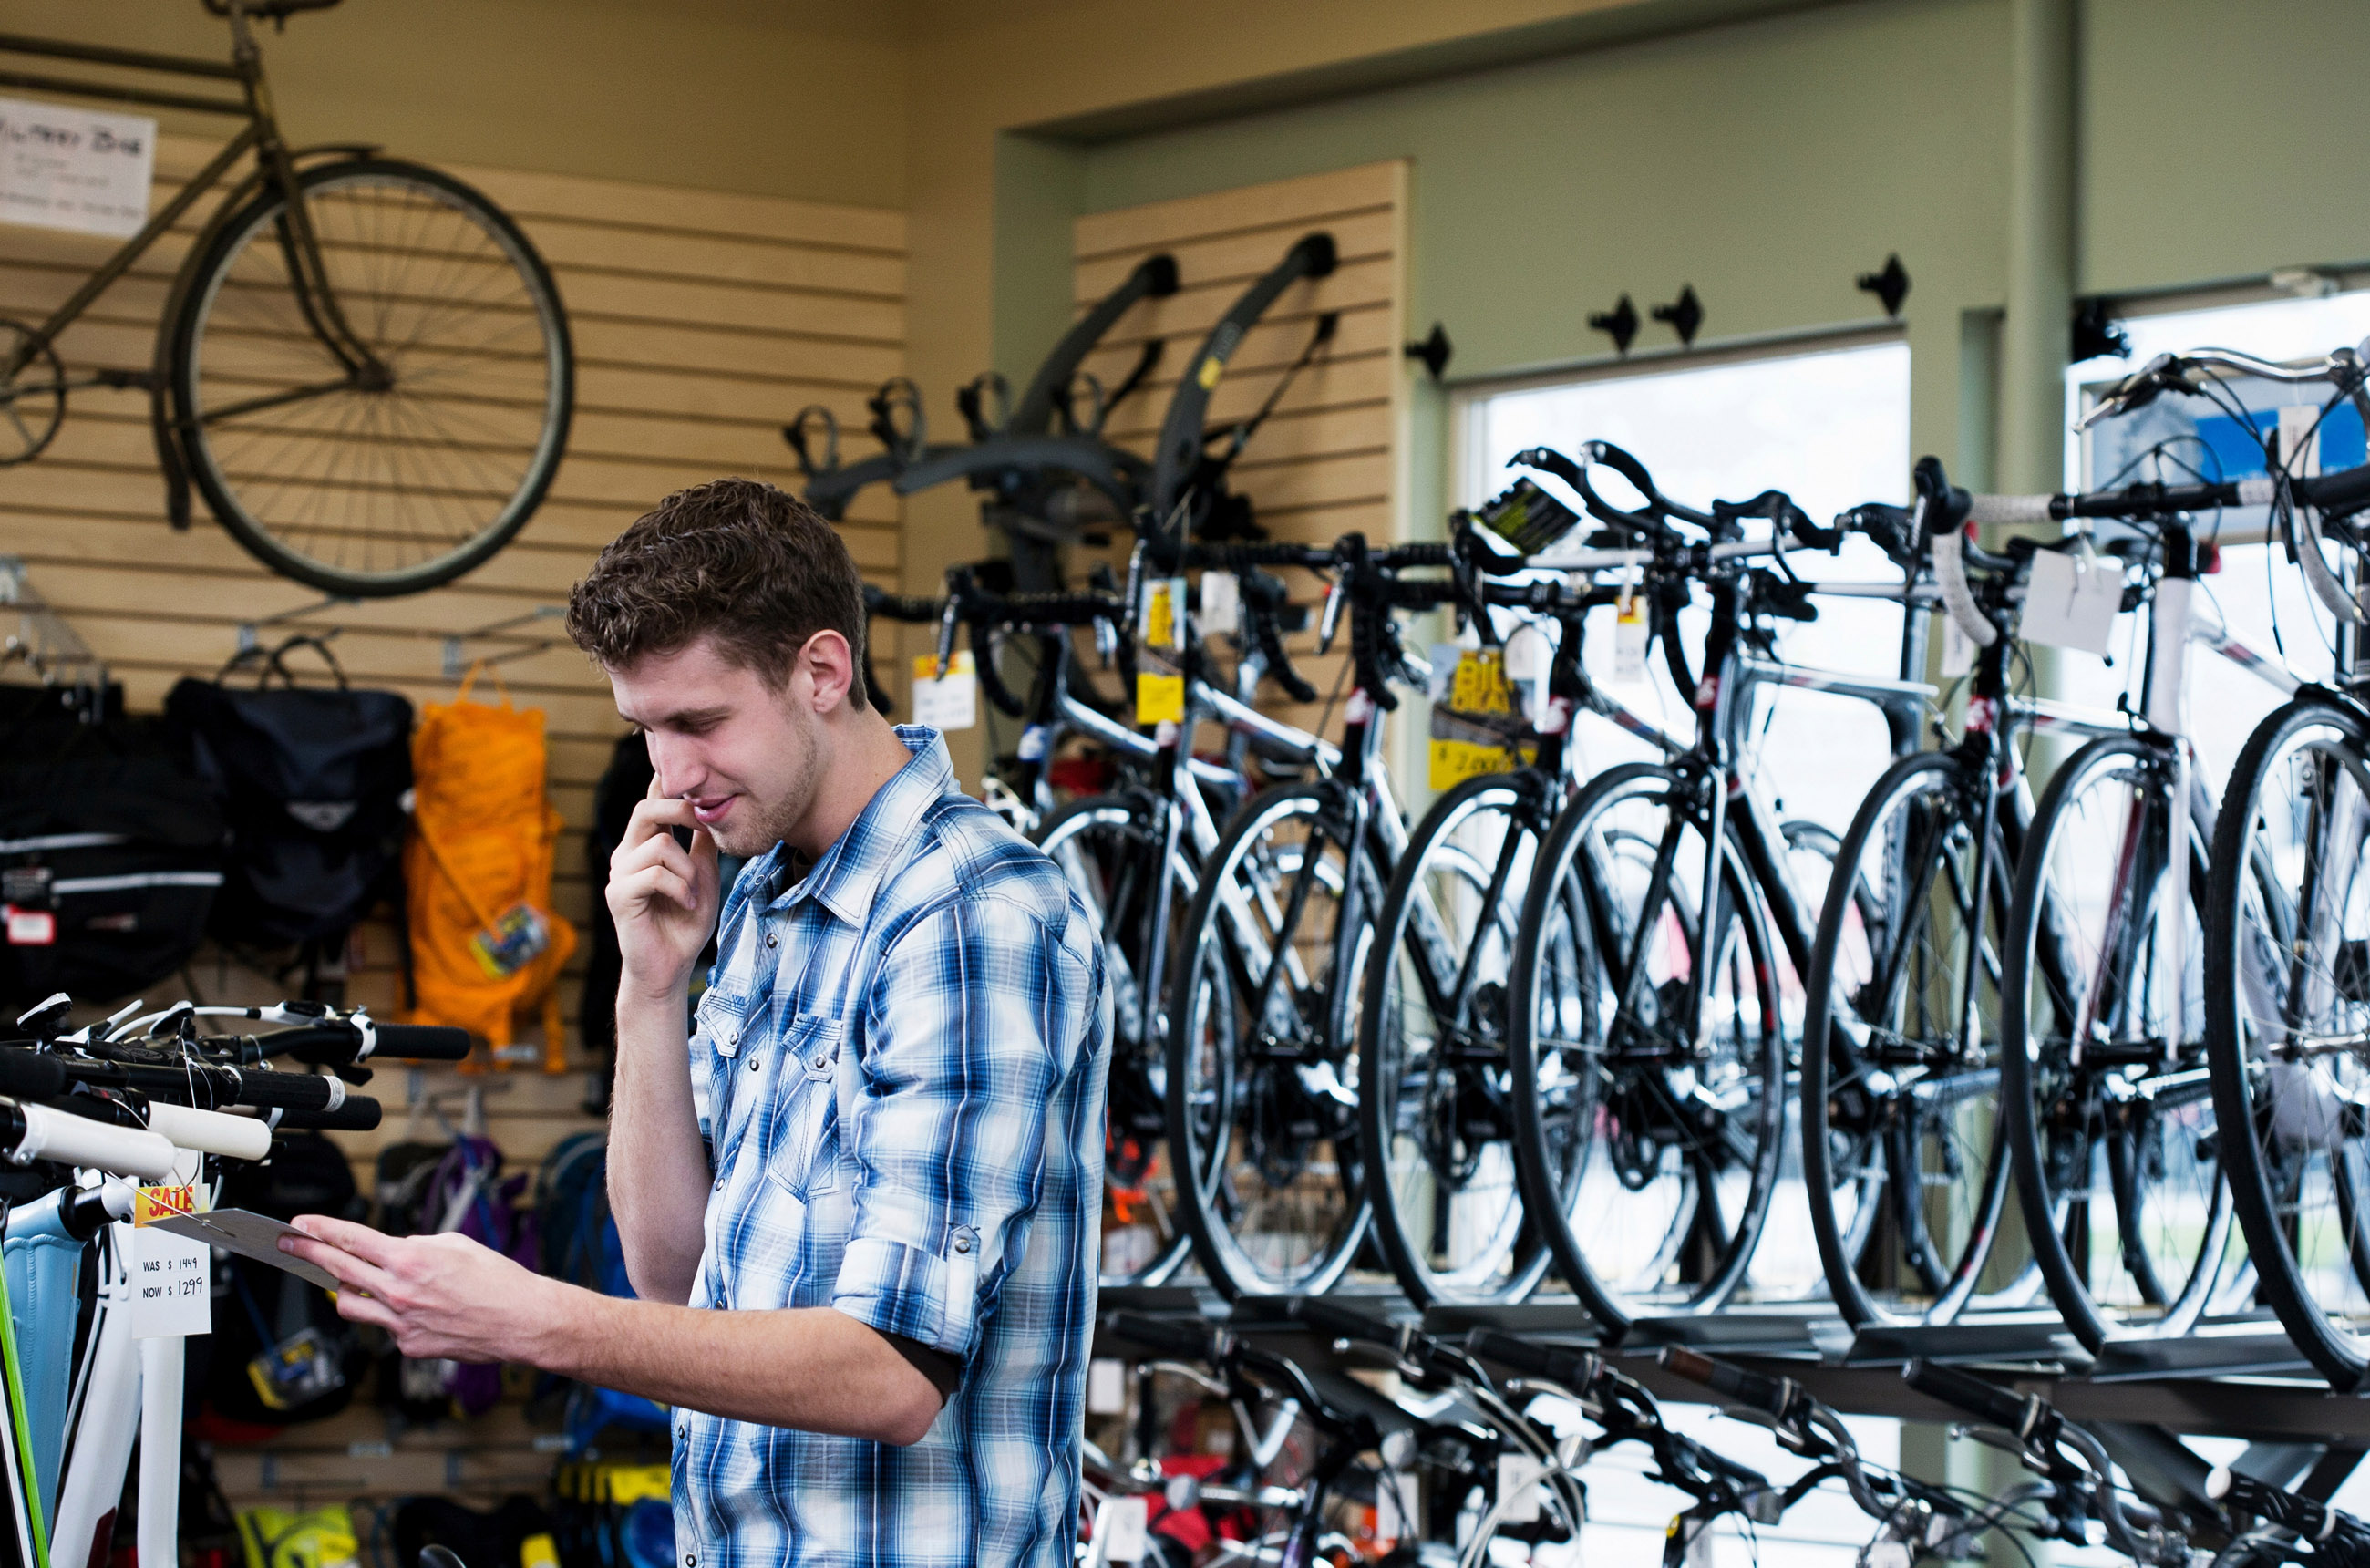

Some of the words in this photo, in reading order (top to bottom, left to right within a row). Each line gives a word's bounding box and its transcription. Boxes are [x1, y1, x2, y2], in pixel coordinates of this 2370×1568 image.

[149, 1186, 193, 1217] SALE
[142, 1261, 160, 1272] WAS
[179, 1257, 198, 1270] 1449
[142, 1286, 162, 1298] NOW
[177, 1276, 203, 1295] 1299
